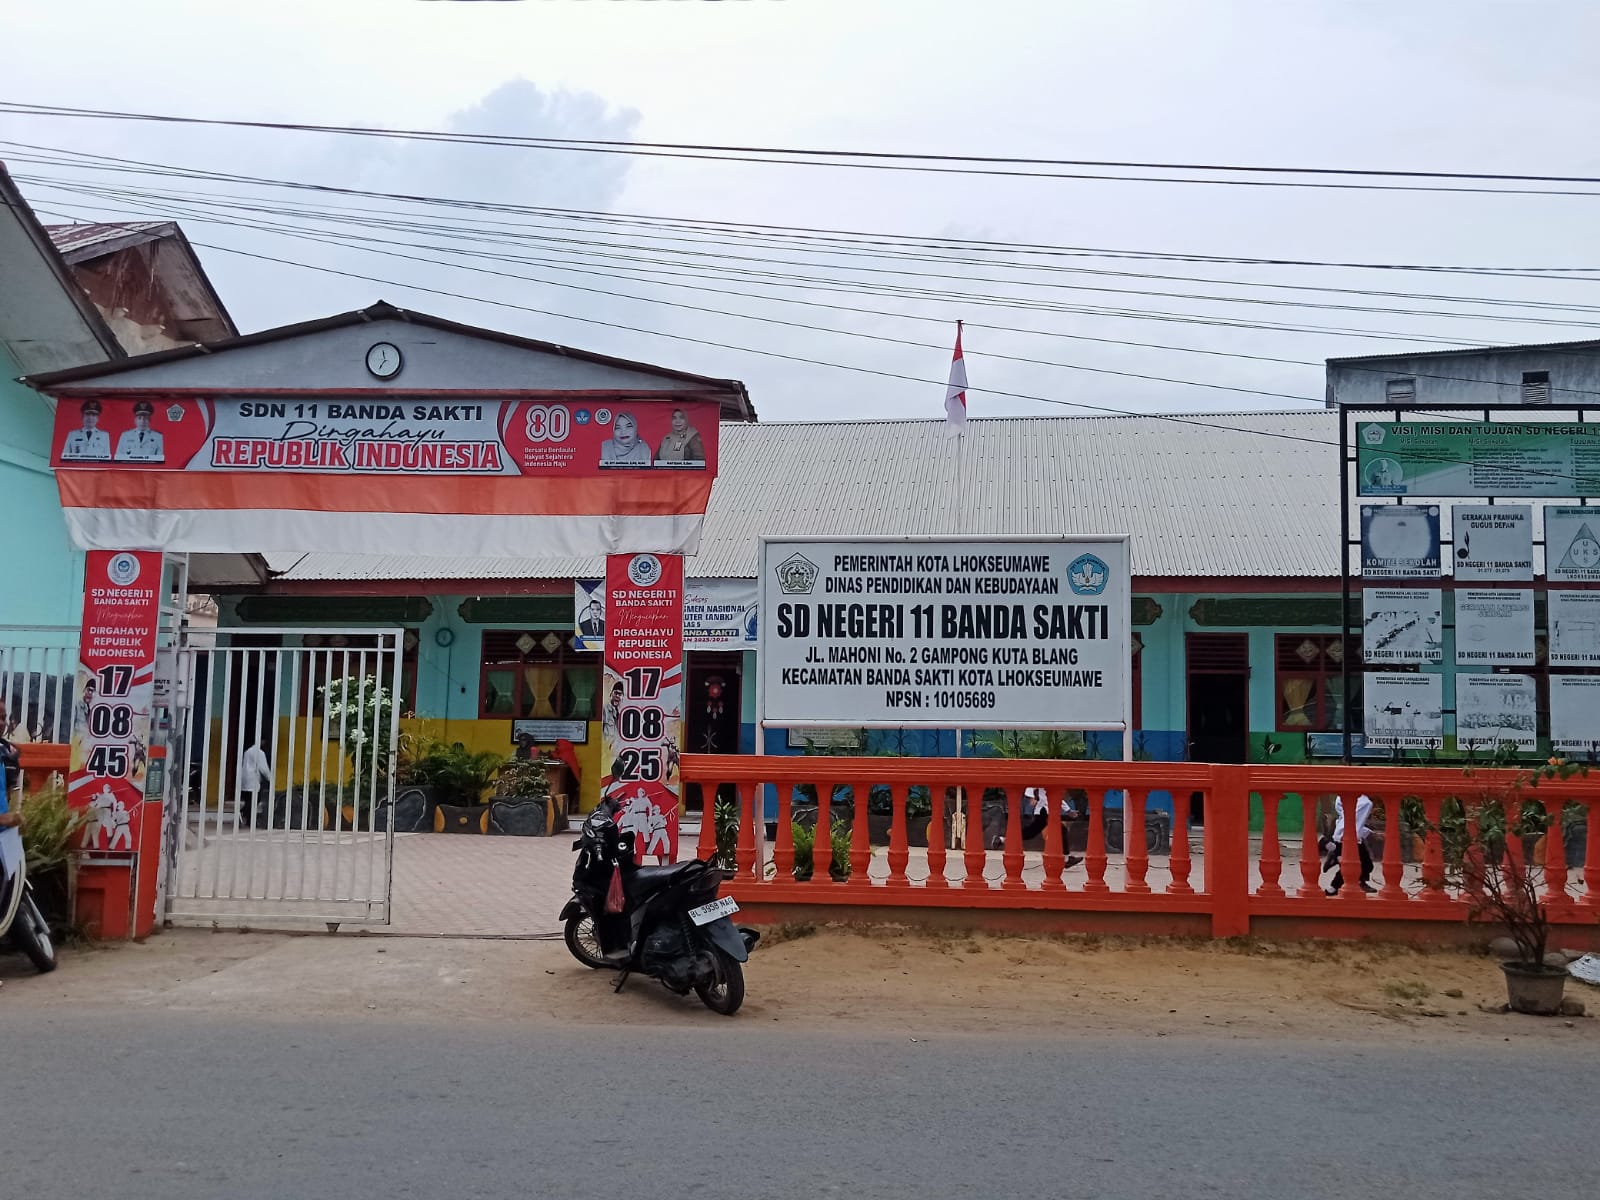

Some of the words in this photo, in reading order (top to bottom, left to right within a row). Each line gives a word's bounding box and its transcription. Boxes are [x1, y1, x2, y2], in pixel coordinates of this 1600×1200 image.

[239, 402, 285, 418] SDN
[294, 403, 318, 418] 11
[327, 404, 405, 419] BANDA
[413, 405, 482, 421] SAKTI
[525, 404, 570, 442] 80
[1421, 426, 1445, 435] MISI
[1449, 426, 1472, 435] DAN
[1476, 426, 1522, 435] TUJUAN
[1526, 426, 1541, 435] SD
[1545, 426, 1587, 436] NEGERI
[213, 439, 350, 467] REPUBLIK
[355, 442, 502, 469] INDONESIA
[833, 555, 913, 573] PEMERINTAH
[916, 555, 951, 573] KOTA
[953, 555, 1050, 573] LHOKSEUMAWE
[825, 576, 863, 594] DINAS
[866, 576, 943, 595] PENDIDIKAN
[945, 577, 971, 595] DAN
[974, 577, 1059, 595] KEBUDAYAAN
[91, 588, 105, 597] SD
[107, 588, 143, 598] NEGERI
[145, 589, 153, 598] 11
[612, 590, 626, 599] SD
[629, 590, 666, 598] NEGERI
[668, 590, 676, 598] 11
[124, 598, 149, 606] SAKTI
[615, 599, 646, 607] BANDA
[647, 599, 673, 607] SAKTI
[705, 613, 733, 621] (ANBK)
[776, 603, 811, 639] SD
[817, 603, 904, 639] NEGERI
[909, 604, 935, 639] 11
[941, 604, 1027, 640] BANDA
[1033, 604, 1109, 640] SAKTI
[89, 627, 148, 635] DIRGAHAYU
[613, 628, 674, 637] DIRGAHAYU
[93, 637, 142, 646] REPUBLIK
[618, 639, 668, 648] REPUBLIK
[88, 648, 145, 657] INDONESIA
[613, 650, 673, 659] INDONESIA
[805, 646, 825, 664] JL.
[828, 647, 882, 664] MAHONI
[885, 647, 906, 664] No.
[909, 647, 918, 664] 2
[921, 647, 988, 665] GAMPONG
[992, 648, 1029, 665] KUTA
[1032, 648, 1079, 665] BLANG
[1365, 650, 1372, 658] SD
[1374, 650, 1394, 658] NEGERI
[1396, 650, 1402, 658] 11
[1404, 650, 1423, 658] BANDA
[1424, 651, 1441, 659] SAKTI
[1489, 651, 1495, 659] 11
[98, 665, 134, 696] 17
[624, 667, 662, 698] 17
[782, 668, 863, 686] KECAMATAN
[866, 669, 911, 686] BANDA
[914, 669, 955, 686] SAKTI
[958, 669, 994, 687] KOTA
[997, 669, 1103, 688] LHOKSEUMAWE
[885, 690, 922, 708] NPSN
[933, 691, 996, 709] 10105689
[91, 704, 131, 737] 08
[621, 707, 664, 740] 08
[87, 746, 127, 777] 45
[621, 750, 662, 782] 25
[690, 909, 701, 918] BL
